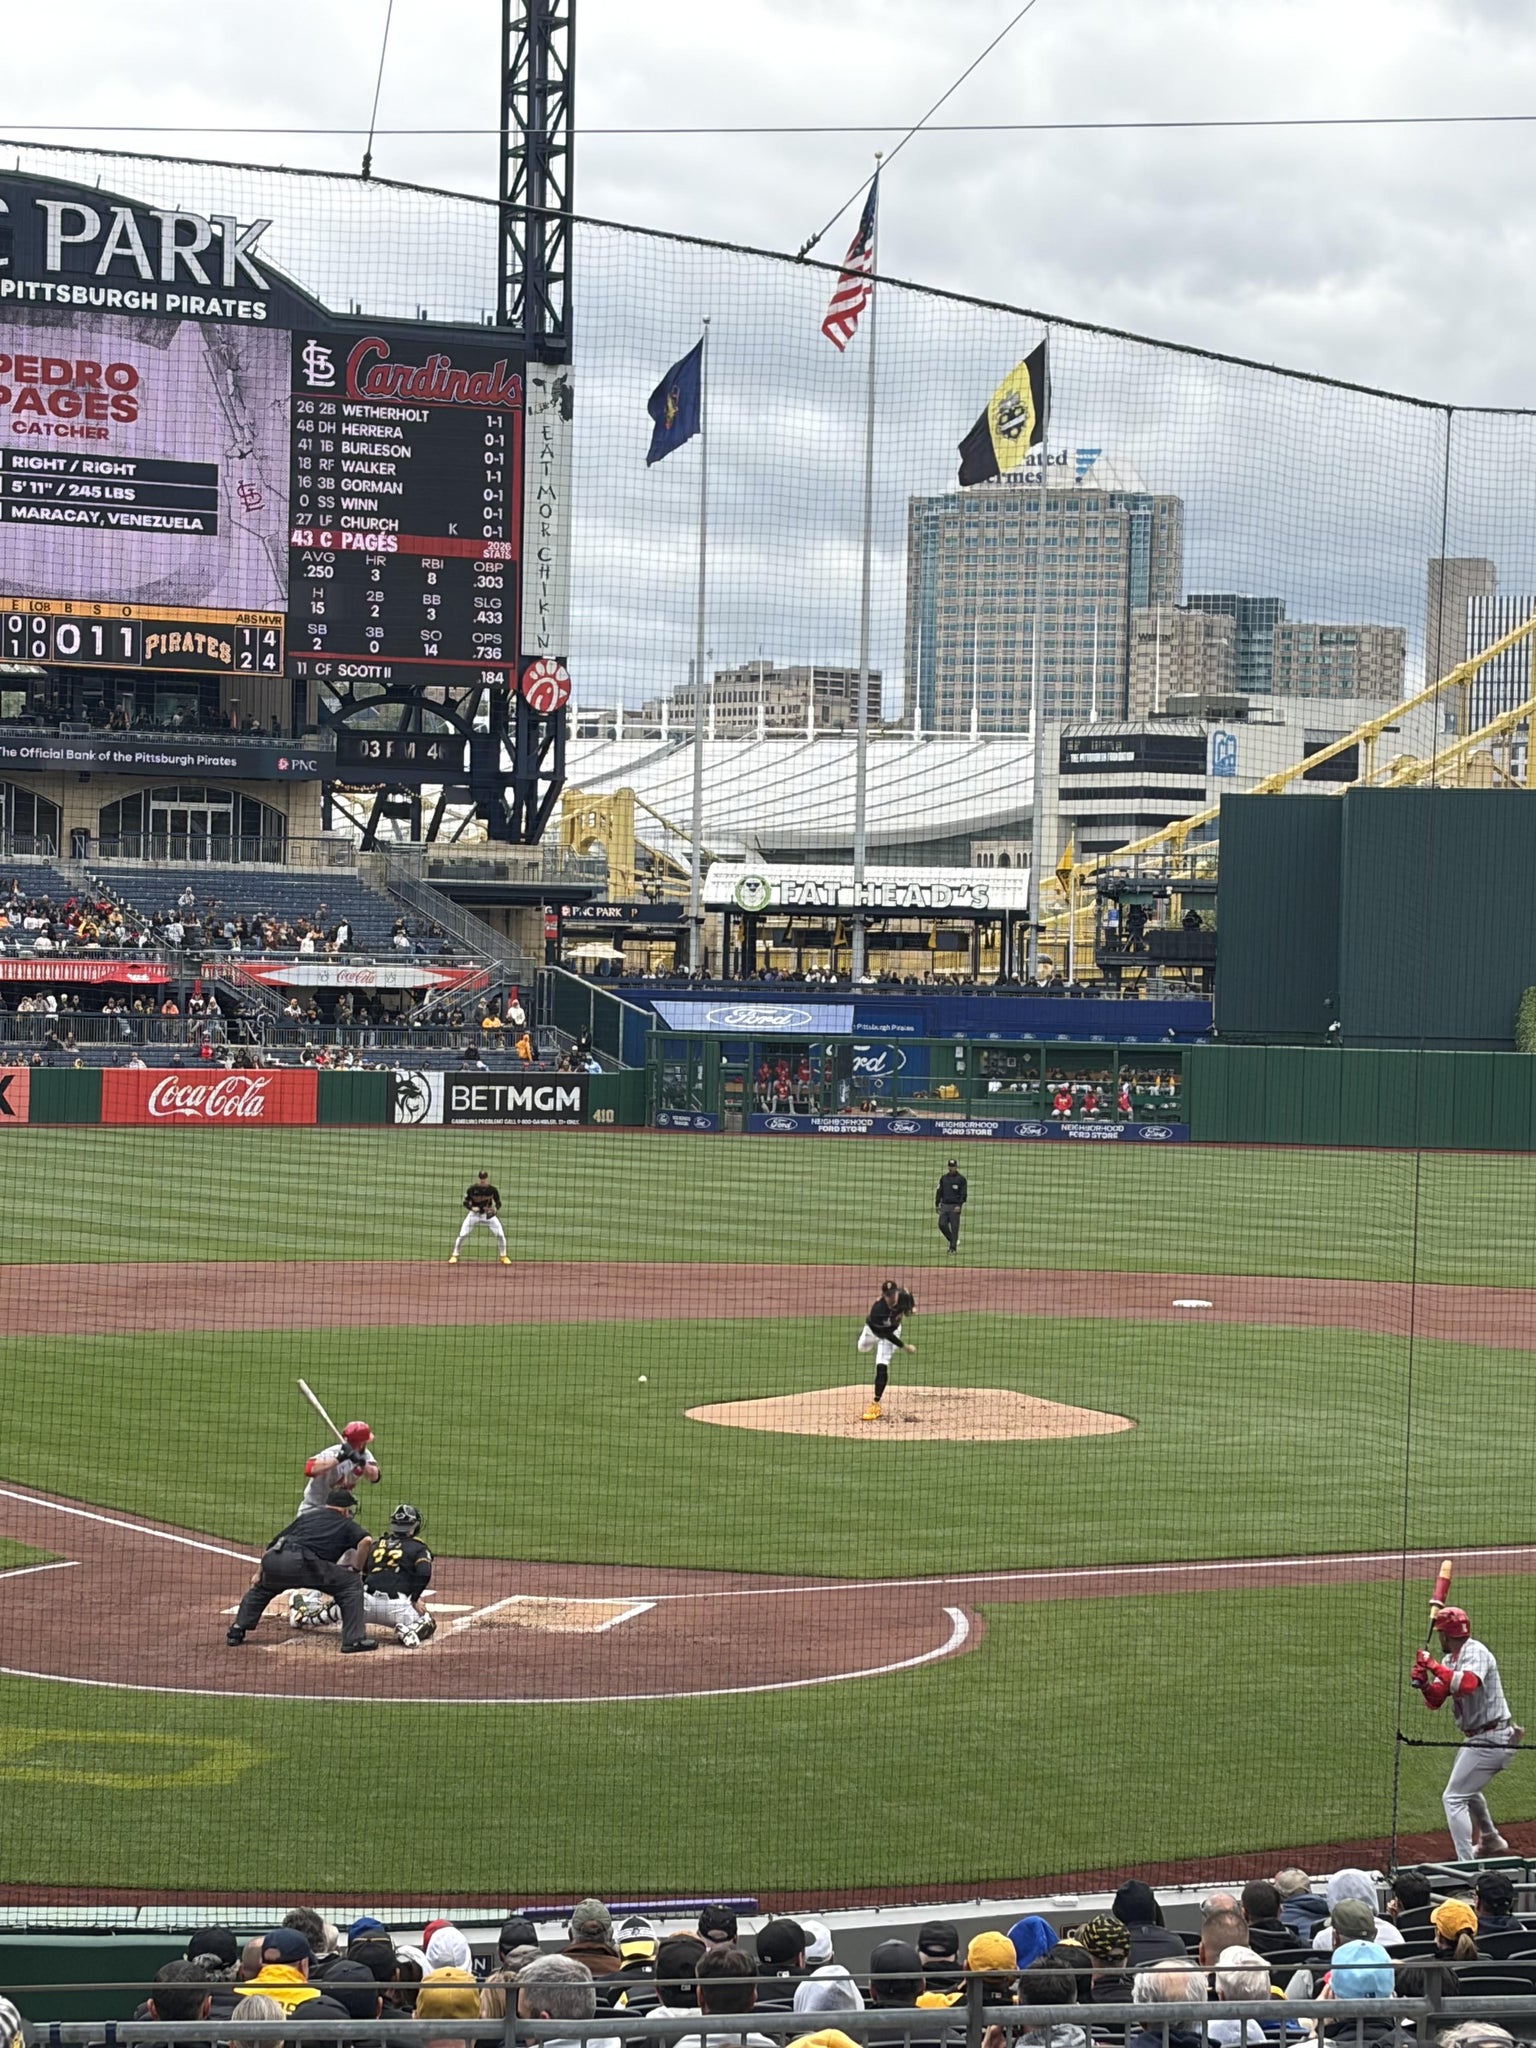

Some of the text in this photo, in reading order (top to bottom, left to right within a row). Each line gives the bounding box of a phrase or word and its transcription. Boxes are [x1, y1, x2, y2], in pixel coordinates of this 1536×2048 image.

[36, 199, 274, 291] PARK
[1, 279, 267, 320] PITTSBURGH PIRATES
[347, 336, 522, 407] Cardinals
[297, 400, 503, 428] 26 2B WETHERHOLT 1-1
[12, 420, 109, 440] CATCHER
[297, 420, 504, 446] 48 DH HERRERA 0-1
[298, 438, 313, 451] 41
[341, 441, 411, 458] BURLESON
[484, 451, 504, 465] 0-1
[540, 425, 554, 477] EAT
[12, 455, 67, 472] RIGHT
[83, 461, 136, 476] RIGHT
[298, 457, 502, 483] 18 RF WALKER 1-1
[69, 484, 101, 498] 245
[105, 487, 136, 501] LBS
[298, 475, 503, 502] 16 3B GORMAN 0-1
[12, 506, 203, 531] MARACAY, VENEZUELA
[299, 495, 503, 520] 0 SS WINN 0-1
[537, 484, 556, 537] MOR
[296, 513, 503, 538] 27 LF CHURCH K 0-1
[291, 531, 313, 547] 43
[320, 532, 332, 547] C
[487, 541, 512, 551] 2026
[301, 551, 504, 573] AVG HR RBI OBP
[483, 550, 512, 560] STATS
[303, 566, 504, 589] .250 3 8 .303
[12, 600, 20, 610] E
[65, 602, 72, 613] B
[93, 604, 101, 615] S
[122, 606, 132, 617] O
[313, 587, 502, 609] H 2B BB SLG
[536, 547, 553, 649] CHIKIN
[8, 616, 46, 633] 0 0
[236, 613, 282, 625] ABS MVR
[311, 602, 503, 625] 15 2 3 .433
[56, 623, 132, 657] 0 1 1
[242, 629, 276, 647] 1 4
[307, 623, 502, 645] SB 3B SO OPS
[11, 639, 46, 658] 1 0
[144, 631, 232, 665] PIRATES
[313, 638, 502, 660] 2 0 14 .736
[241, 651, 276, 670] 2 4
[297, 661, 308, 675] 11
[315, 662, 332, 675] CF
[338, 664, 383, 678] SCOTT
[477, 671, 504, 684] .184
[20, 747, 64, 760] Official
[66, 749, 96, 761] Bank
[98, 750, 111, 762] of
[113, 751, 133, 763] the
[135, 752, 194, 766] Pittsburgh
[197, 754, 237, 767] Pirates
[292, 759, 318, 772] PNC
[780, 880, 989, 909] FAT HEAD'S
[572, 906, 622, 918] PNC PARK
[724, 1007, 792, 1026] Ford
[148, 1075, 273, 1117] Coca-Cola
[451, 1085, 582, 1112] BETMGM
[593, 1109, 615, 1124] 410
[811, 1118, 874, 1127] NEIGHBORHOOD
[935, 1121, 999, 1129] NEIGHBORHOOD
[818, 1125, 839, 1133] FORD
[942, 1128, 965, 1136] FORD
[1061, 1124, 1125, 1132] NEIGHBORHOOD
[1069, 1131, 1118, 1139] FORD STORE
